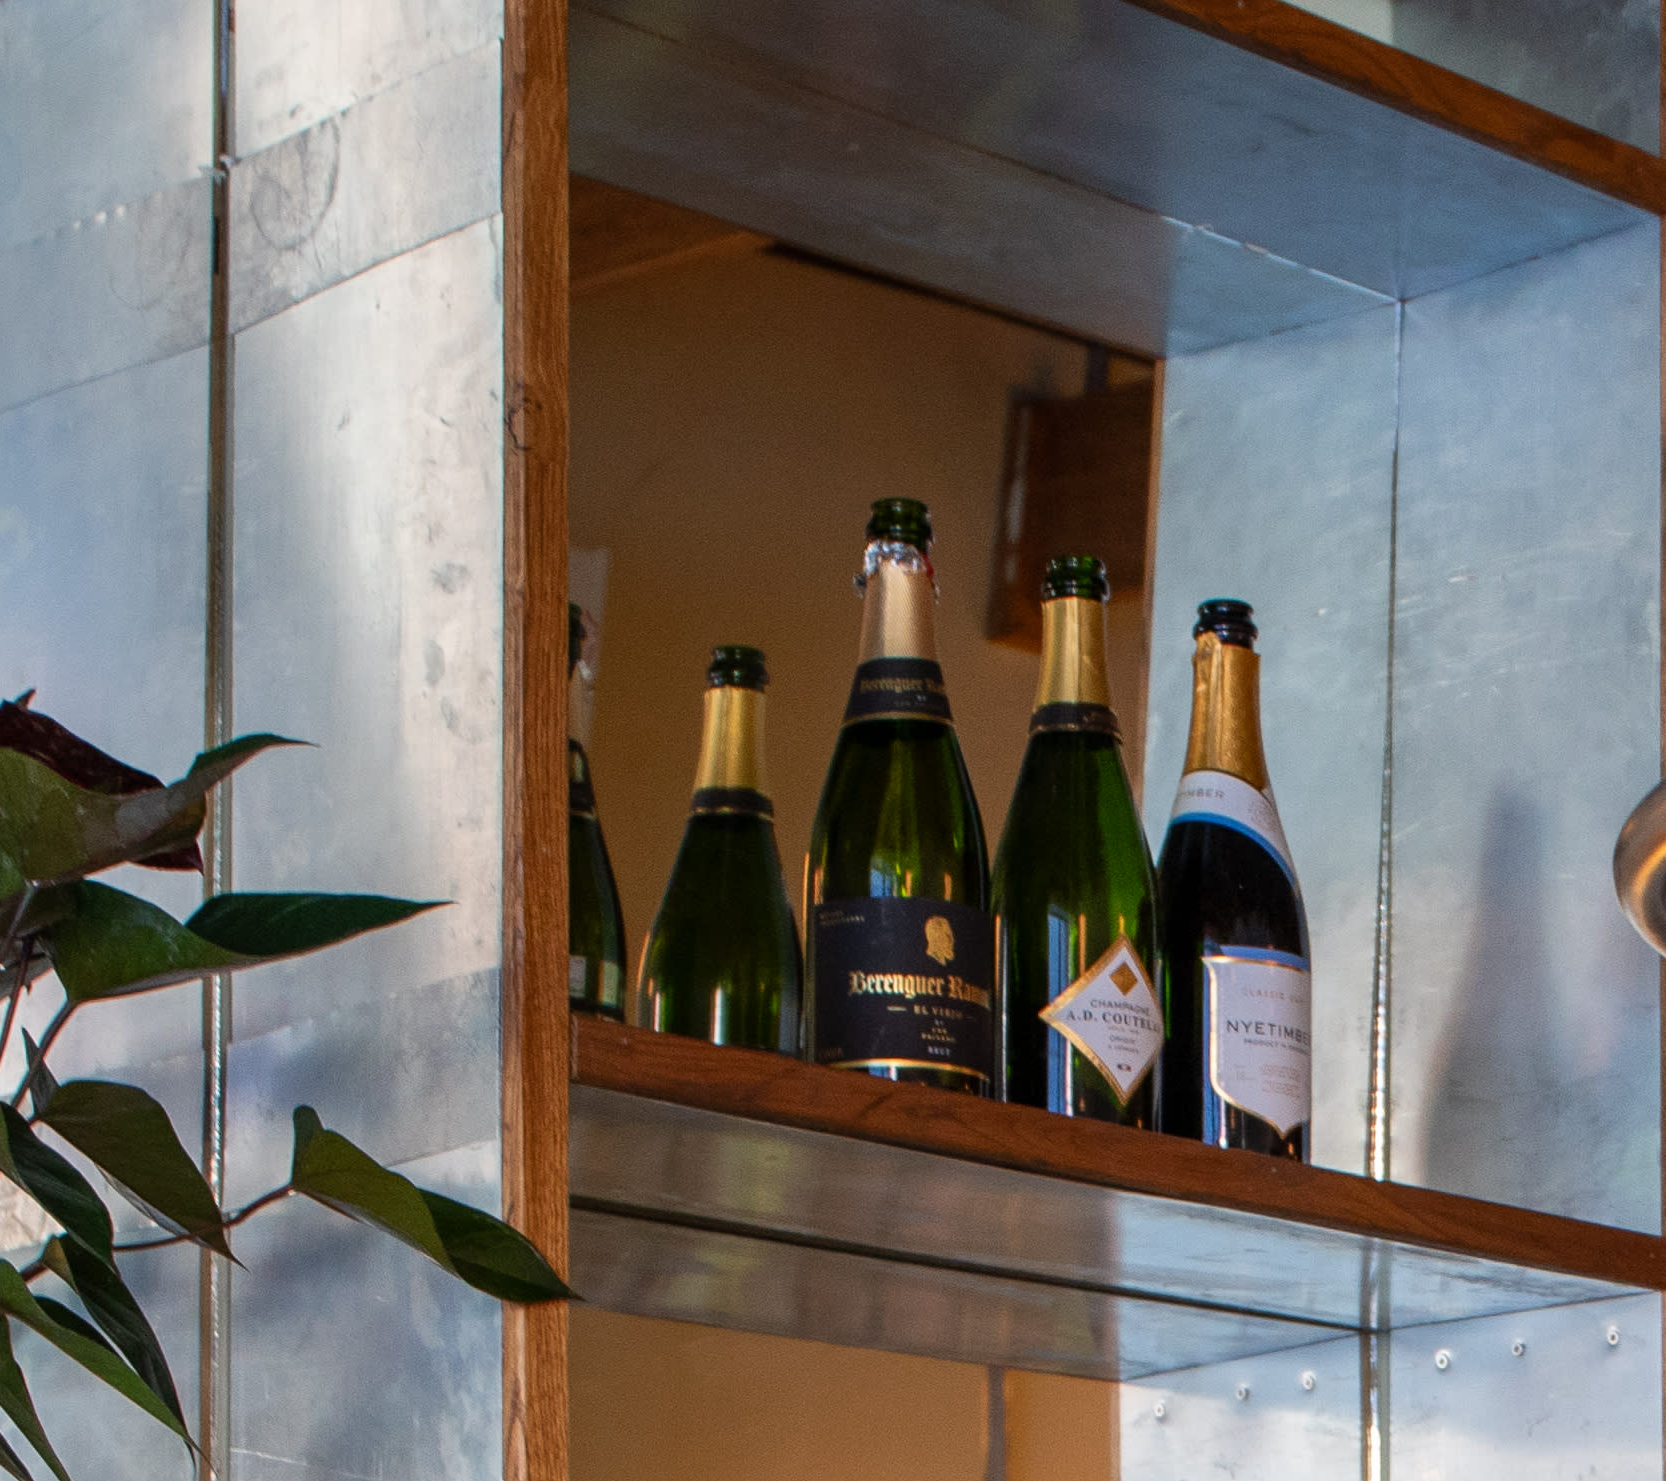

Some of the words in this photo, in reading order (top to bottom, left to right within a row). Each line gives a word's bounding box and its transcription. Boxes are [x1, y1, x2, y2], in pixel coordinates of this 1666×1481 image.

[848, 970, 945, 999] Berenguer
[1066, 1010, 1097, 1022] A.D.
[1090, 1000, 1150, 1017] CHAMPAGNE
